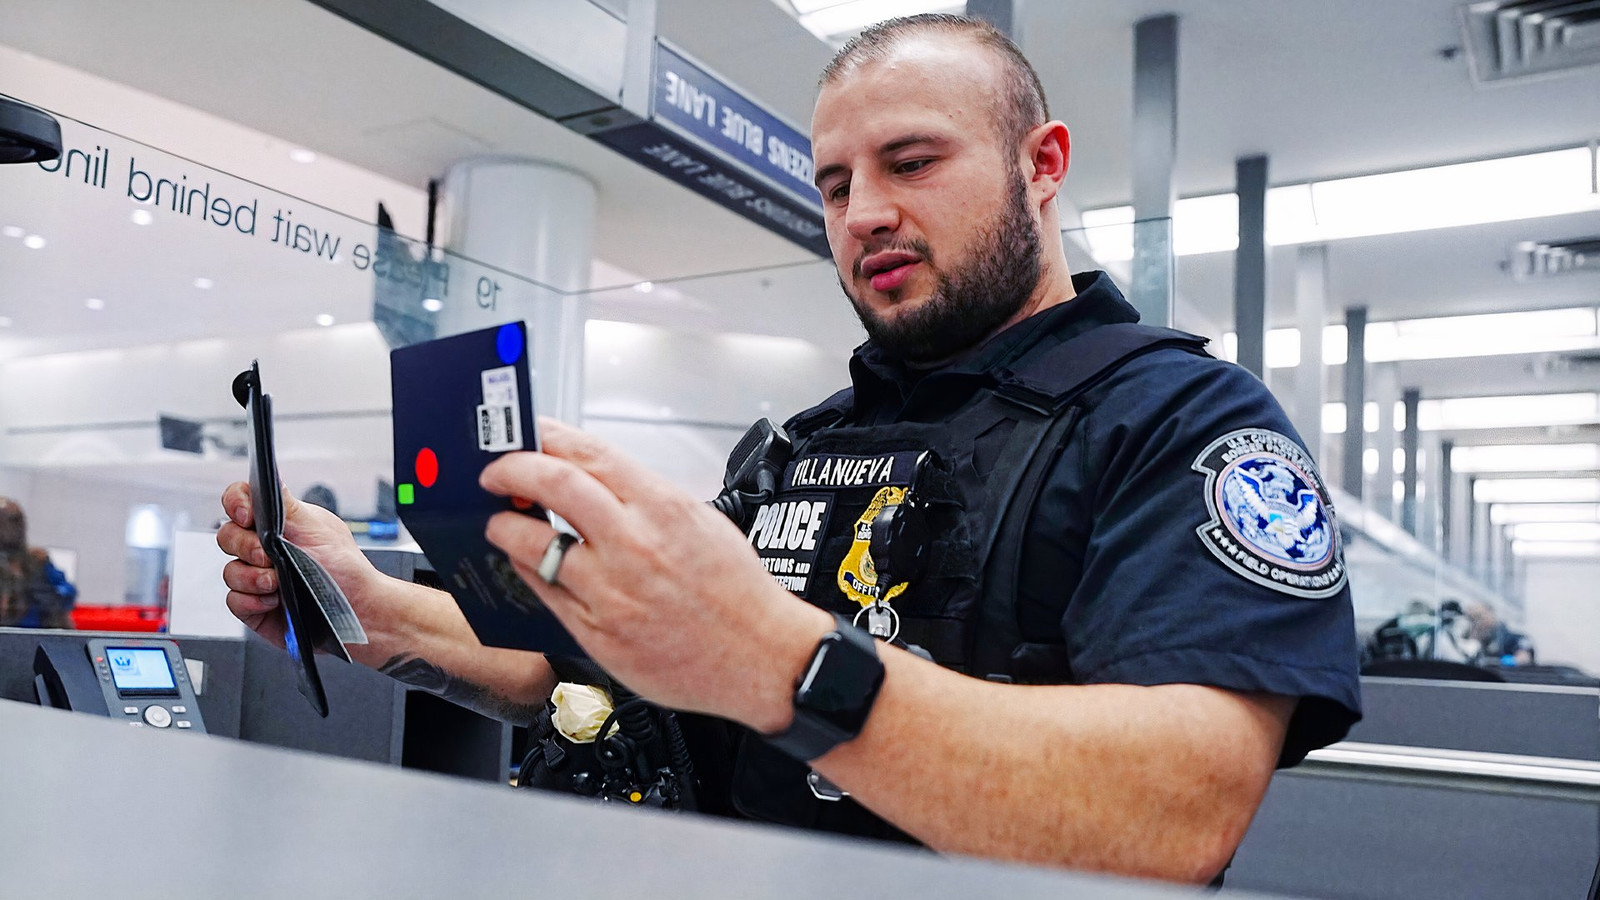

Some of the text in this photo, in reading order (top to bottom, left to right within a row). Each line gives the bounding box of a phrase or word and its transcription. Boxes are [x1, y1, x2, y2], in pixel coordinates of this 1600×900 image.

[664, 71, 717, 128] LANE
[721, 106, 764, 156] BLUE
[791, 455, 895, 487] VILLANUEVA
[747, 500, 827, 550] POLICE
[794, 563, 811, 574] AND
[1235, 550, 1270, 576] FIELD
[772, 575, 808, 592] TECTION
